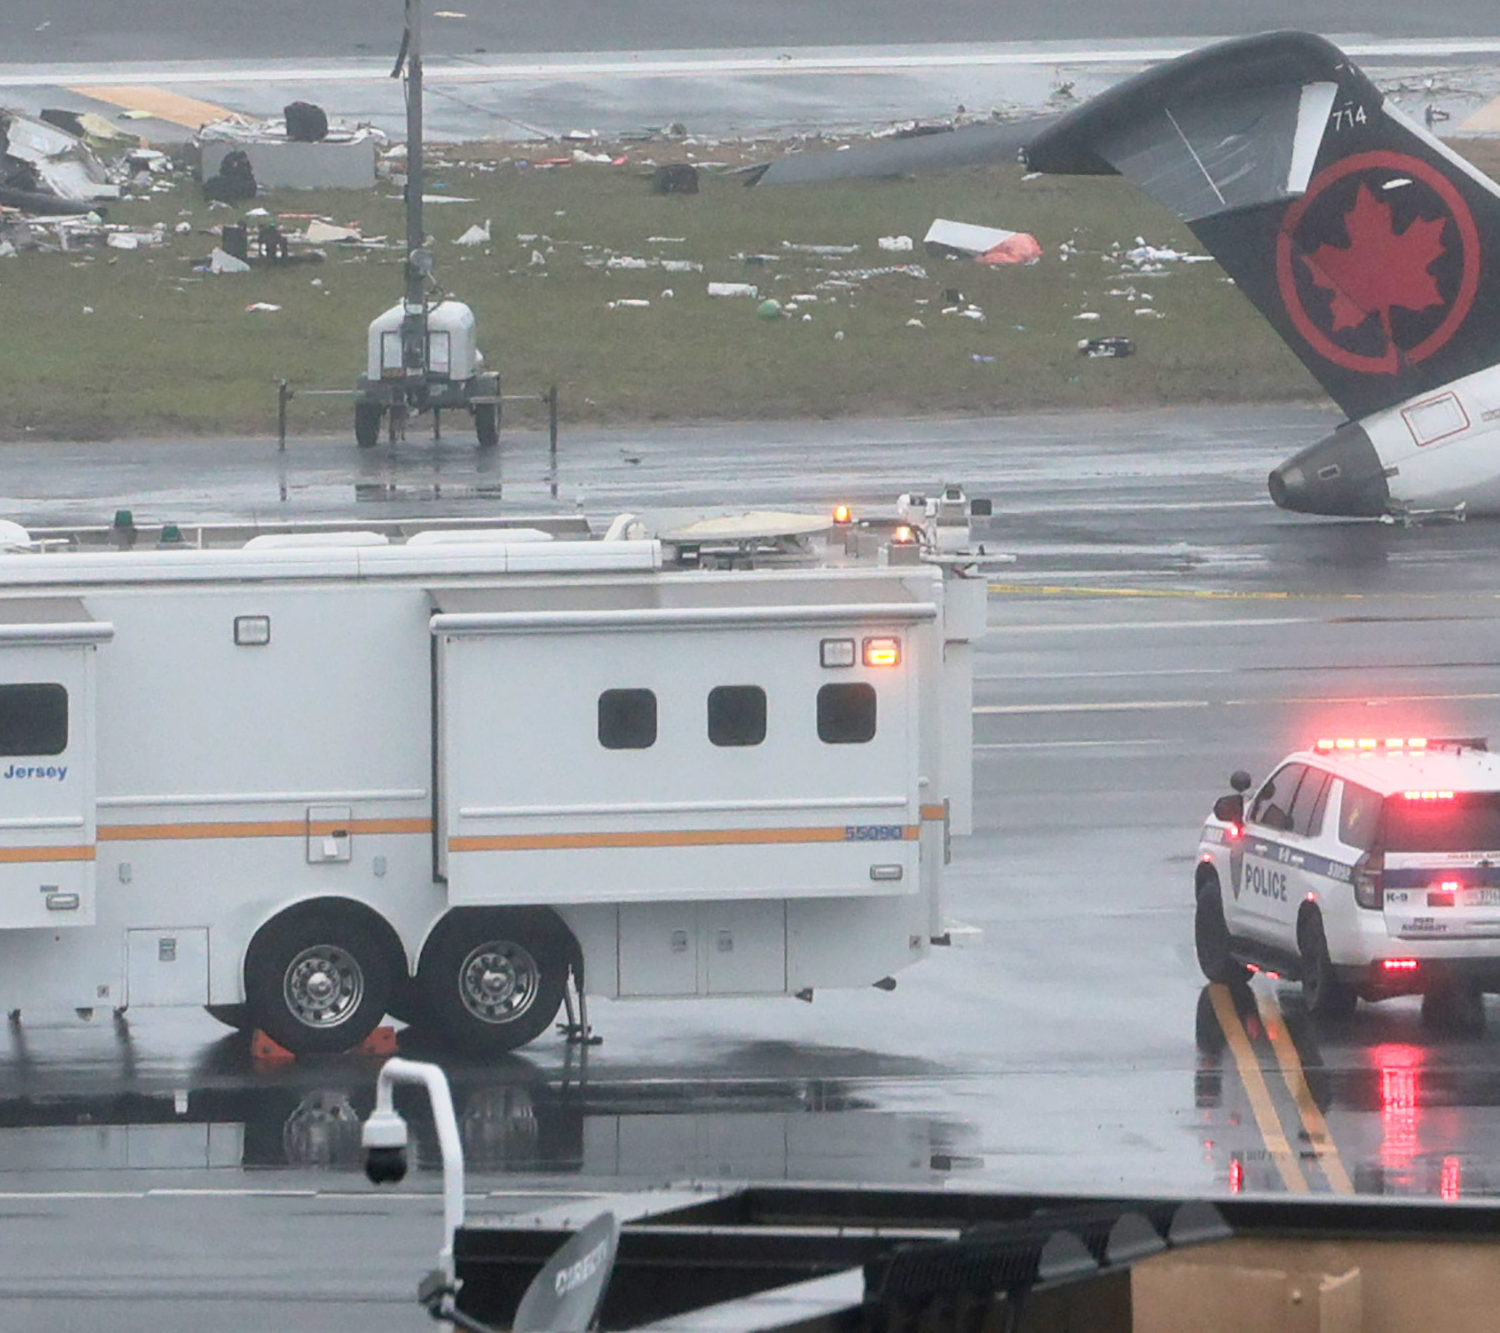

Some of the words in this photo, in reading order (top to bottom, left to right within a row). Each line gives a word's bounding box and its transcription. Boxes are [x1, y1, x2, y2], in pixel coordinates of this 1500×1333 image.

[1332, 104, 1367, 131] 714
[4, 764, 69, 781] Jersey
[1245, 863, 1288, 902] POLICE
[1386, 892, 1408, 903] K-9
